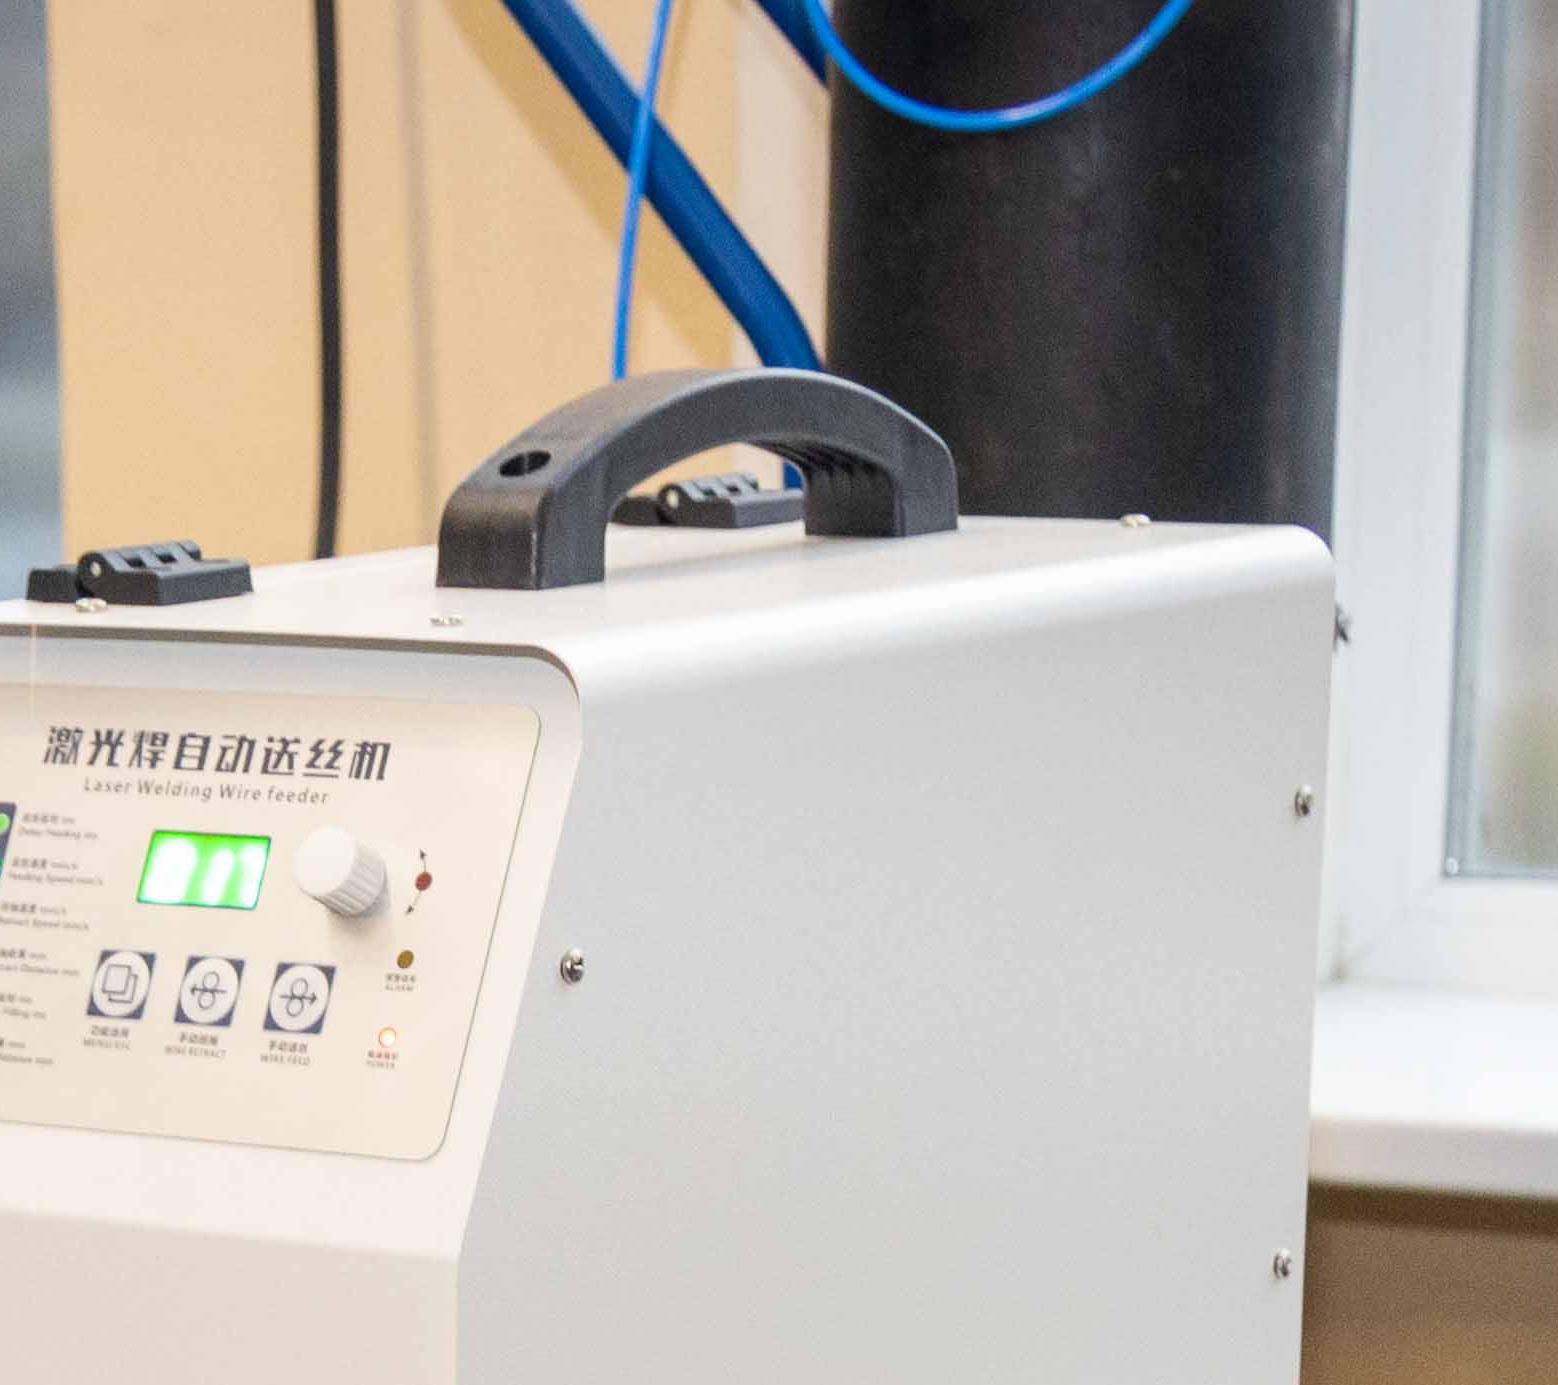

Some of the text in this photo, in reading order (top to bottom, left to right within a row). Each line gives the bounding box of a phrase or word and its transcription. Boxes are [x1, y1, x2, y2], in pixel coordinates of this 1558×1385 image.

[43, 727, 391, 780] 激光焊自动送丝机
[84, 778, 330, 805] Laser Welding Wire feeder
